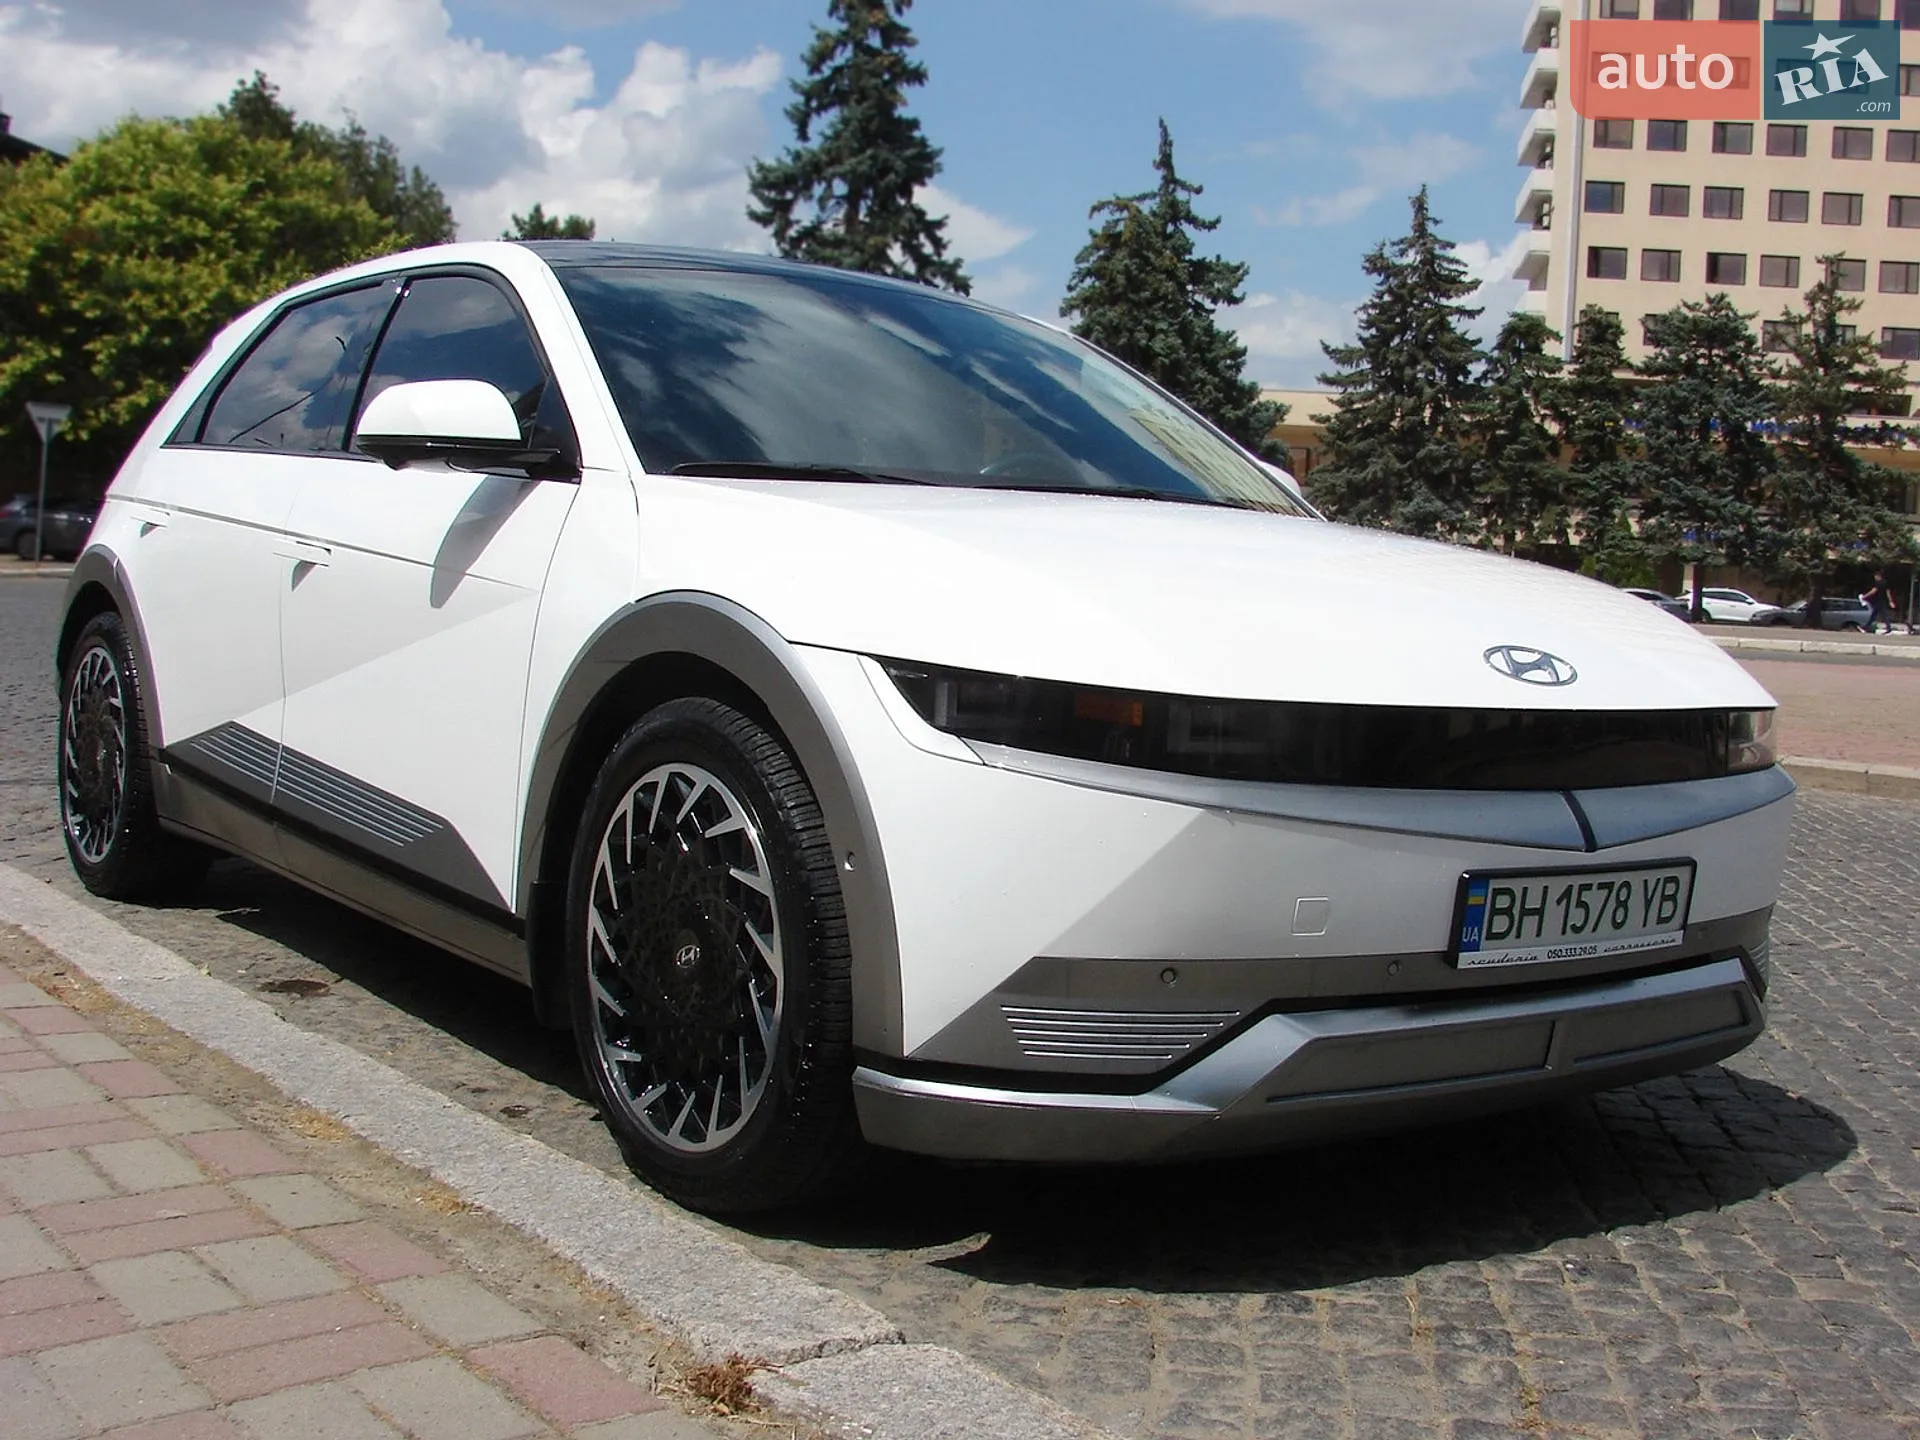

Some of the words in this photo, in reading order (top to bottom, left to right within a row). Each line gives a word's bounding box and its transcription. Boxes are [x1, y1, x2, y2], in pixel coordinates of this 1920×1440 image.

[1485, 885, 1549, 941] BH
[1556, 880, 1632, 936] 1578
[1643, 875, 1681, 928] YB
[1462, 927, 1480, 943] UA
